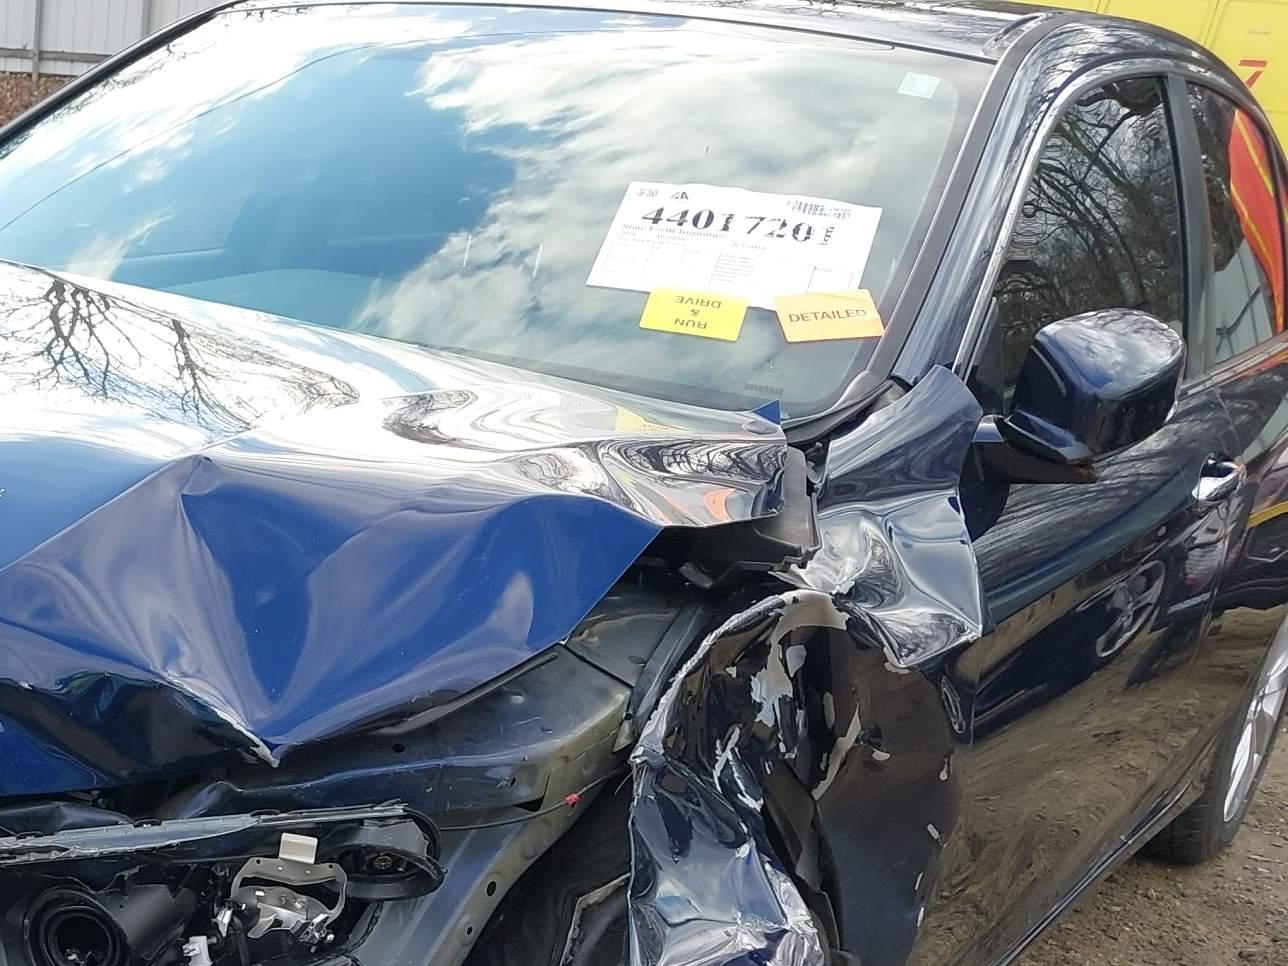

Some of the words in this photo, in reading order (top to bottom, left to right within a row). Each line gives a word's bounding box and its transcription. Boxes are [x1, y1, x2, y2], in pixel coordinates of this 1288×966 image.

[641, 206, 835, 246] 44017201
[674, 295, 722, 309] DRIVE
[689, 308, 701, 317] &
[788, 309, 868, 323] DETAILED
[674, 318, 708, 330] RUN
